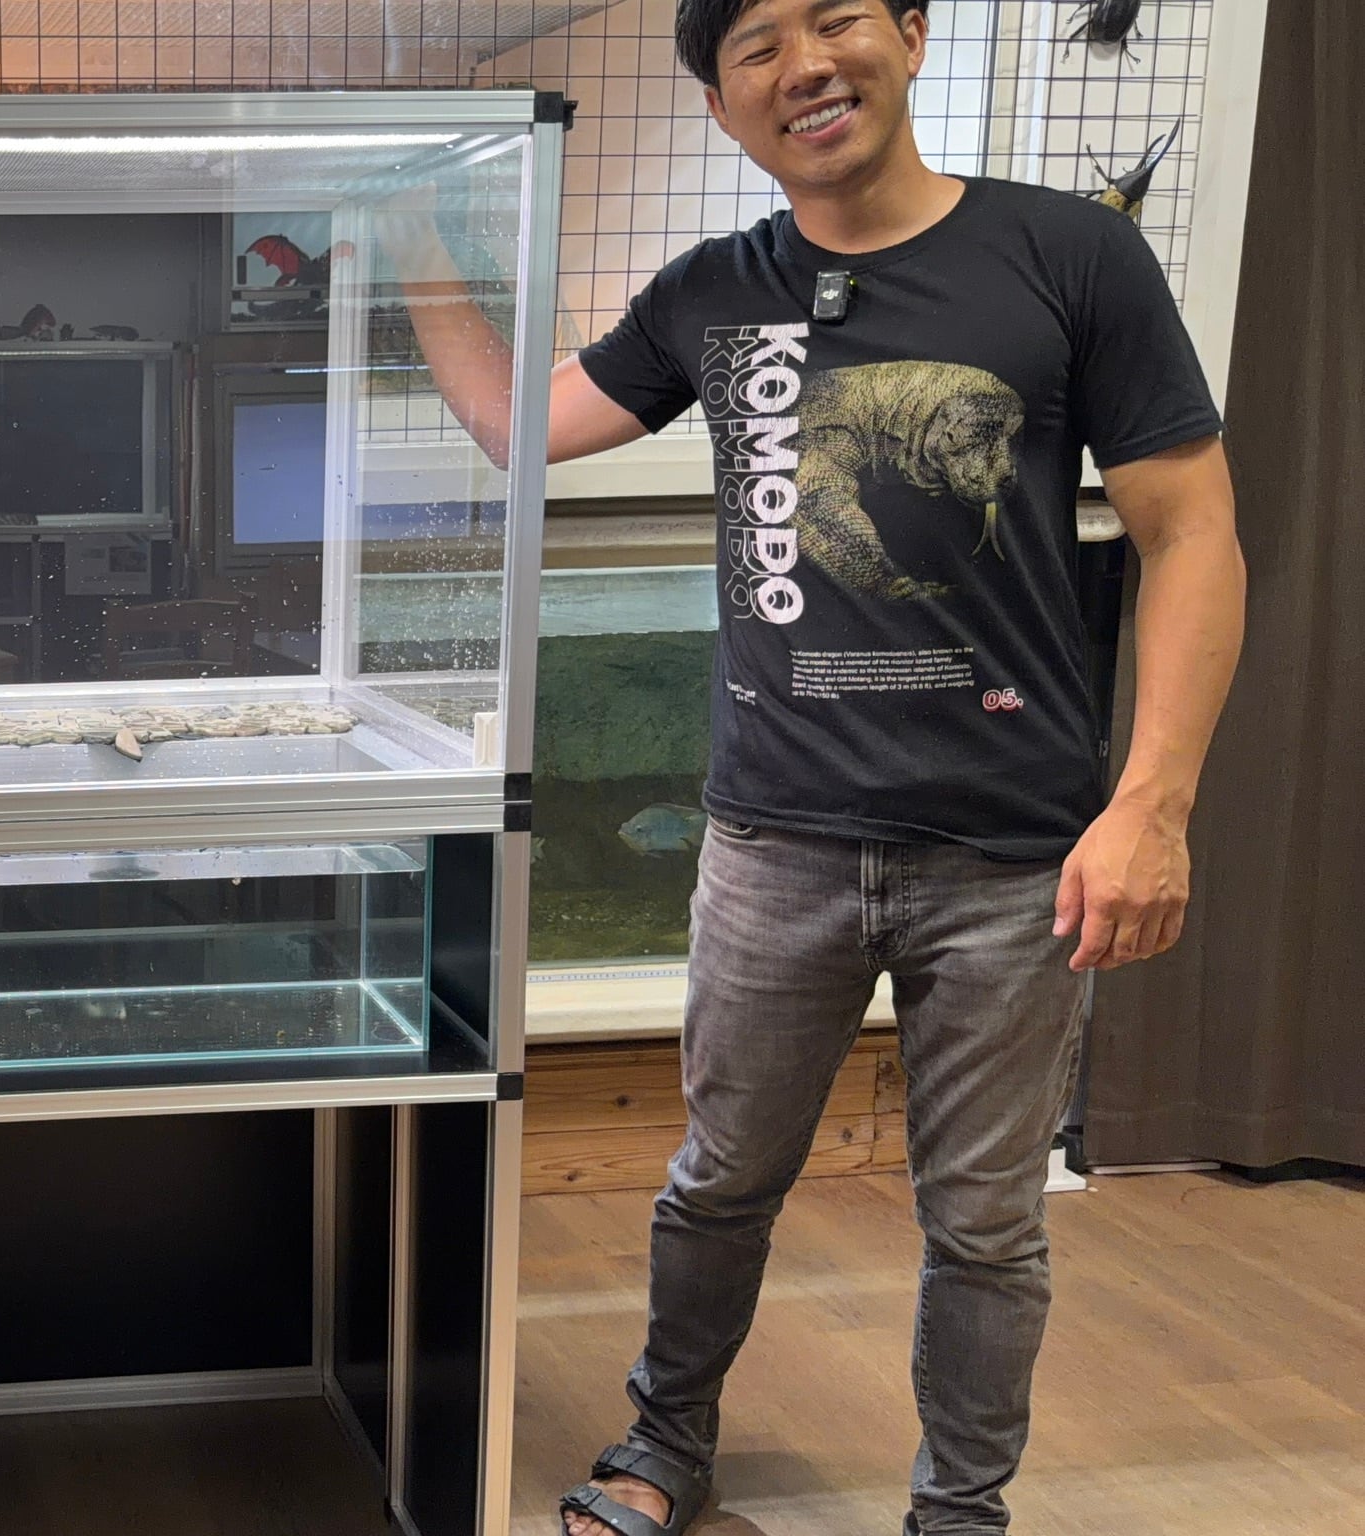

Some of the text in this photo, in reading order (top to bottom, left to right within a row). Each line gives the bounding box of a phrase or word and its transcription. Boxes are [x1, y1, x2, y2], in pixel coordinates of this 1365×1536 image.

[822, 289, 839, 300] dji
[750, 322, 810, 625] KOMODO
[982, 688, 1024, 711] 05.
